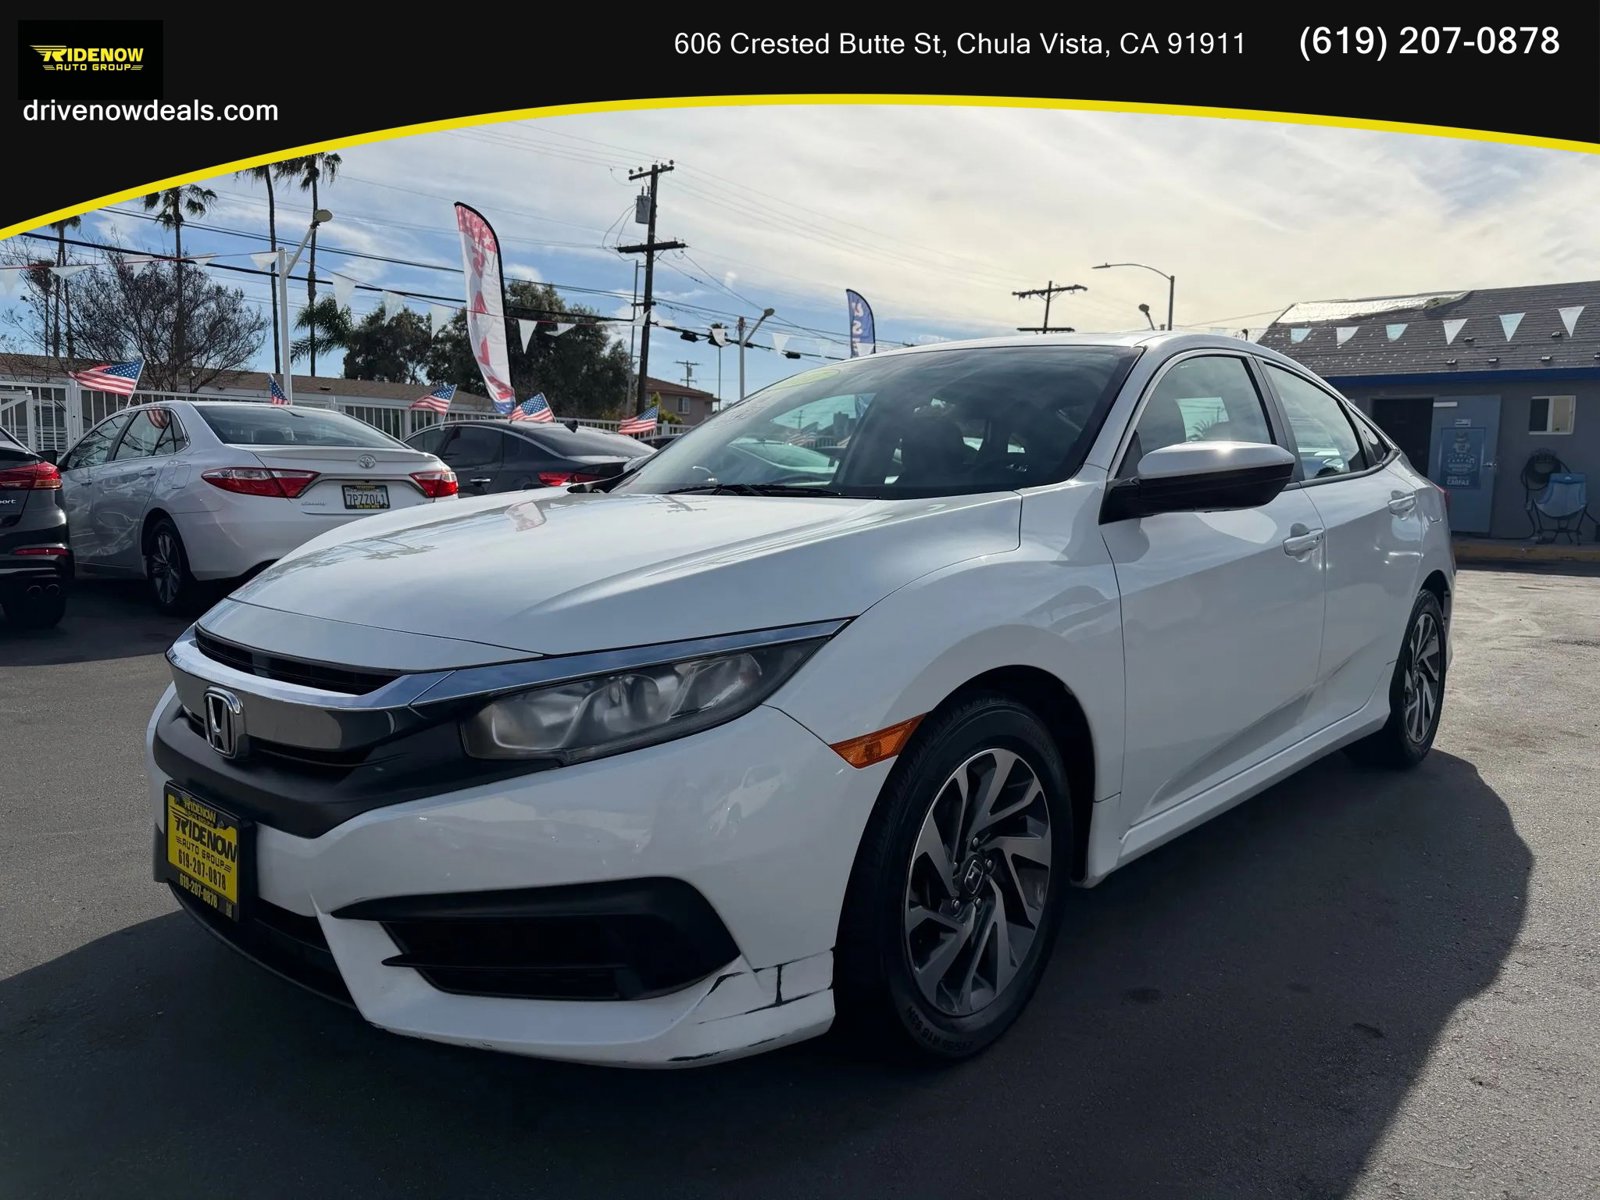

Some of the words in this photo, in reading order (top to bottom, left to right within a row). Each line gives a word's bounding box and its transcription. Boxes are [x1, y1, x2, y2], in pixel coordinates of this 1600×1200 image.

[347, 494, 385, 506] 7PZZ041
[173, 815, 238, 862] RIDENOW
[182, 838, 199, 855] AUTO
[201, 850, 225, 868] GROUP
